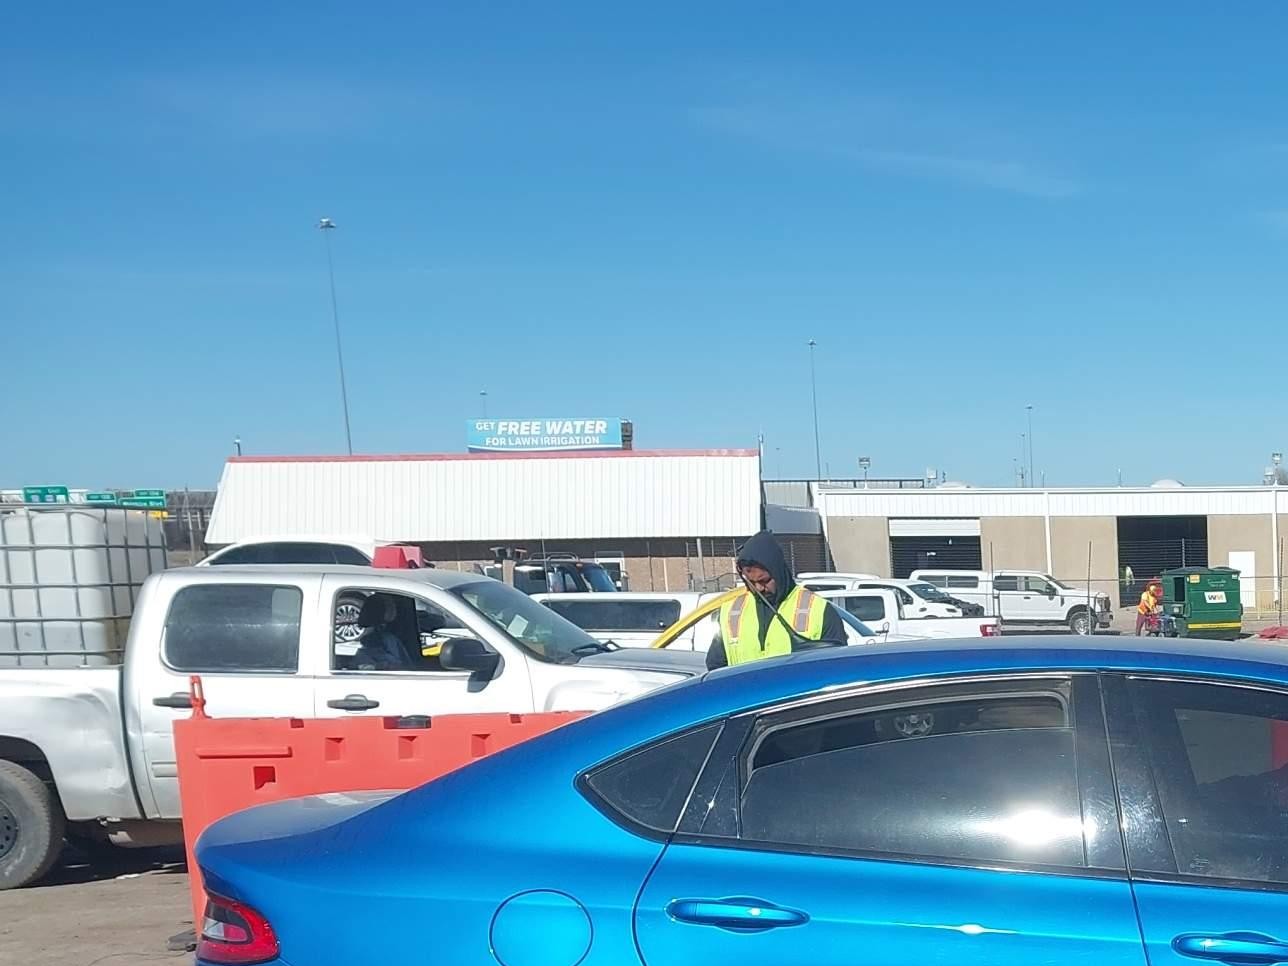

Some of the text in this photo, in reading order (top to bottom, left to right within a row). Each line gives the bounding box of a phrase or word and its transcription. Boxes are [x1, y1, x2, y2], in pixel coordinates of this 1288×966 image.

[475, 420, 607, 435] GET FREE WATER
[486, 436, 600, 446] FOR LAWN IRRIGATION
